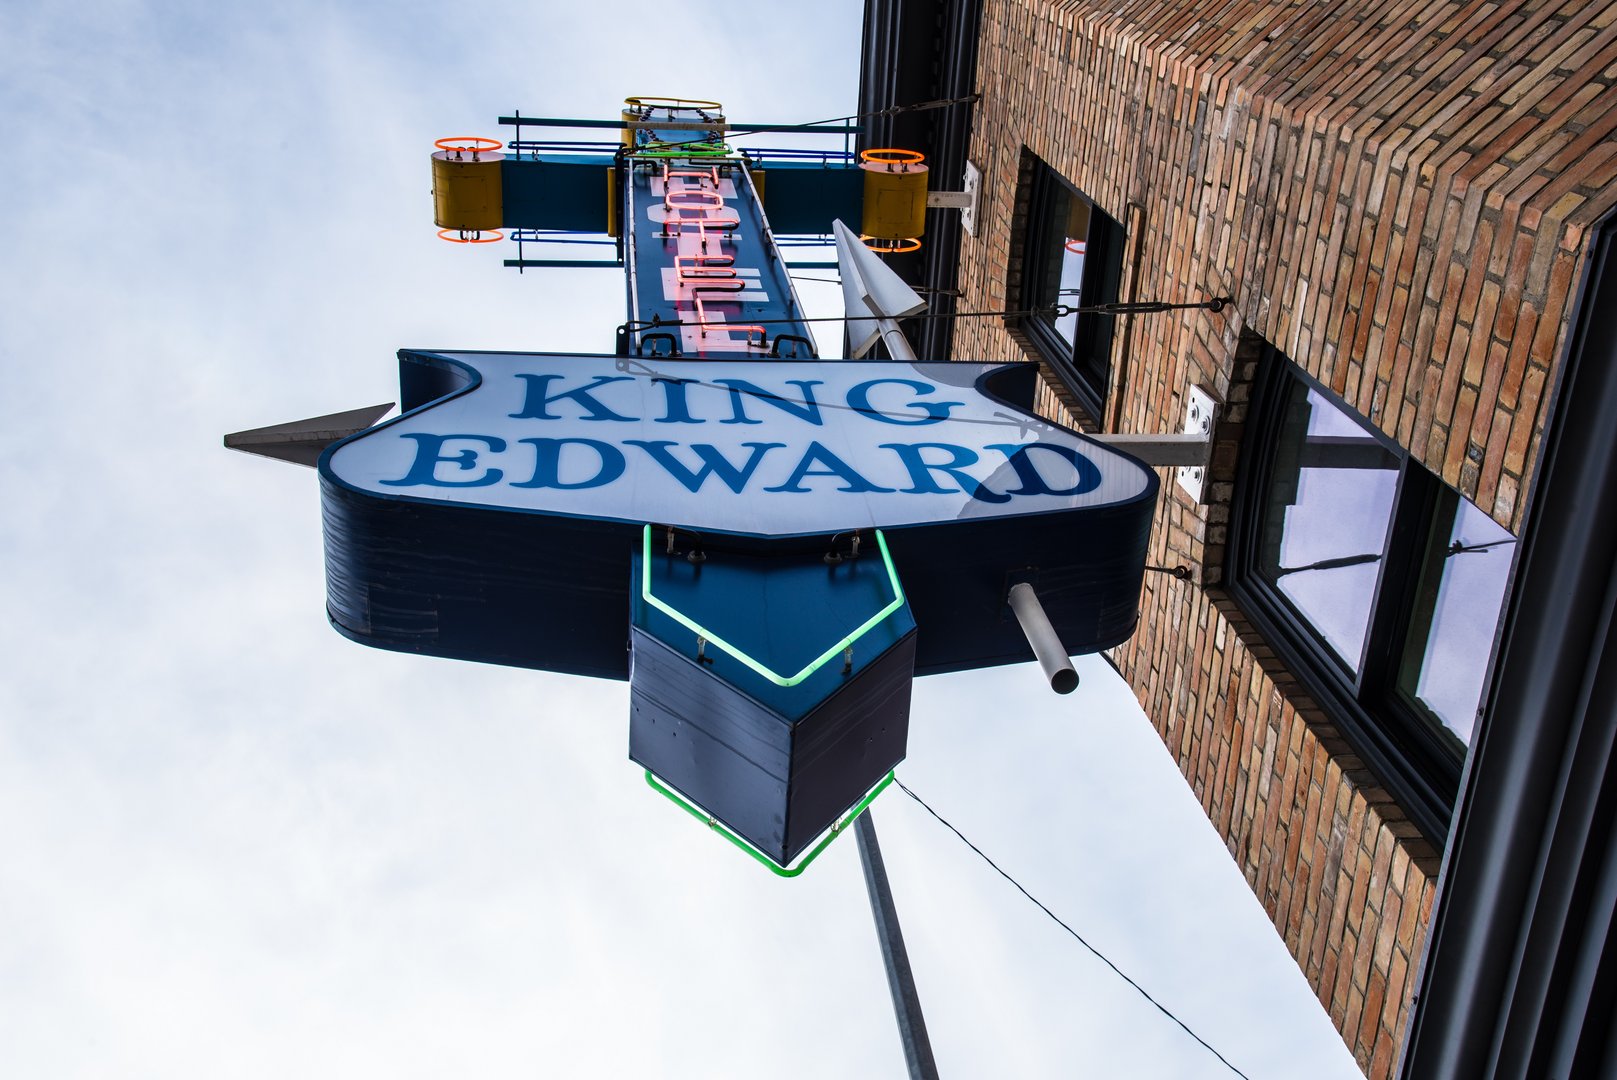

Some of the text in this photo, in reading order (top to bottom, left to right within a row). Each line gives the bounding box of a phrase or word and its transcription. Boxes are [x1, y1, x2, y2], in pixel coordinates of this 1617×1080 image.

[647, 165, 769, 353] HOTEL
[509, 373, 965, 426] KING
[379, 432, 1102, 504] EDWARD
